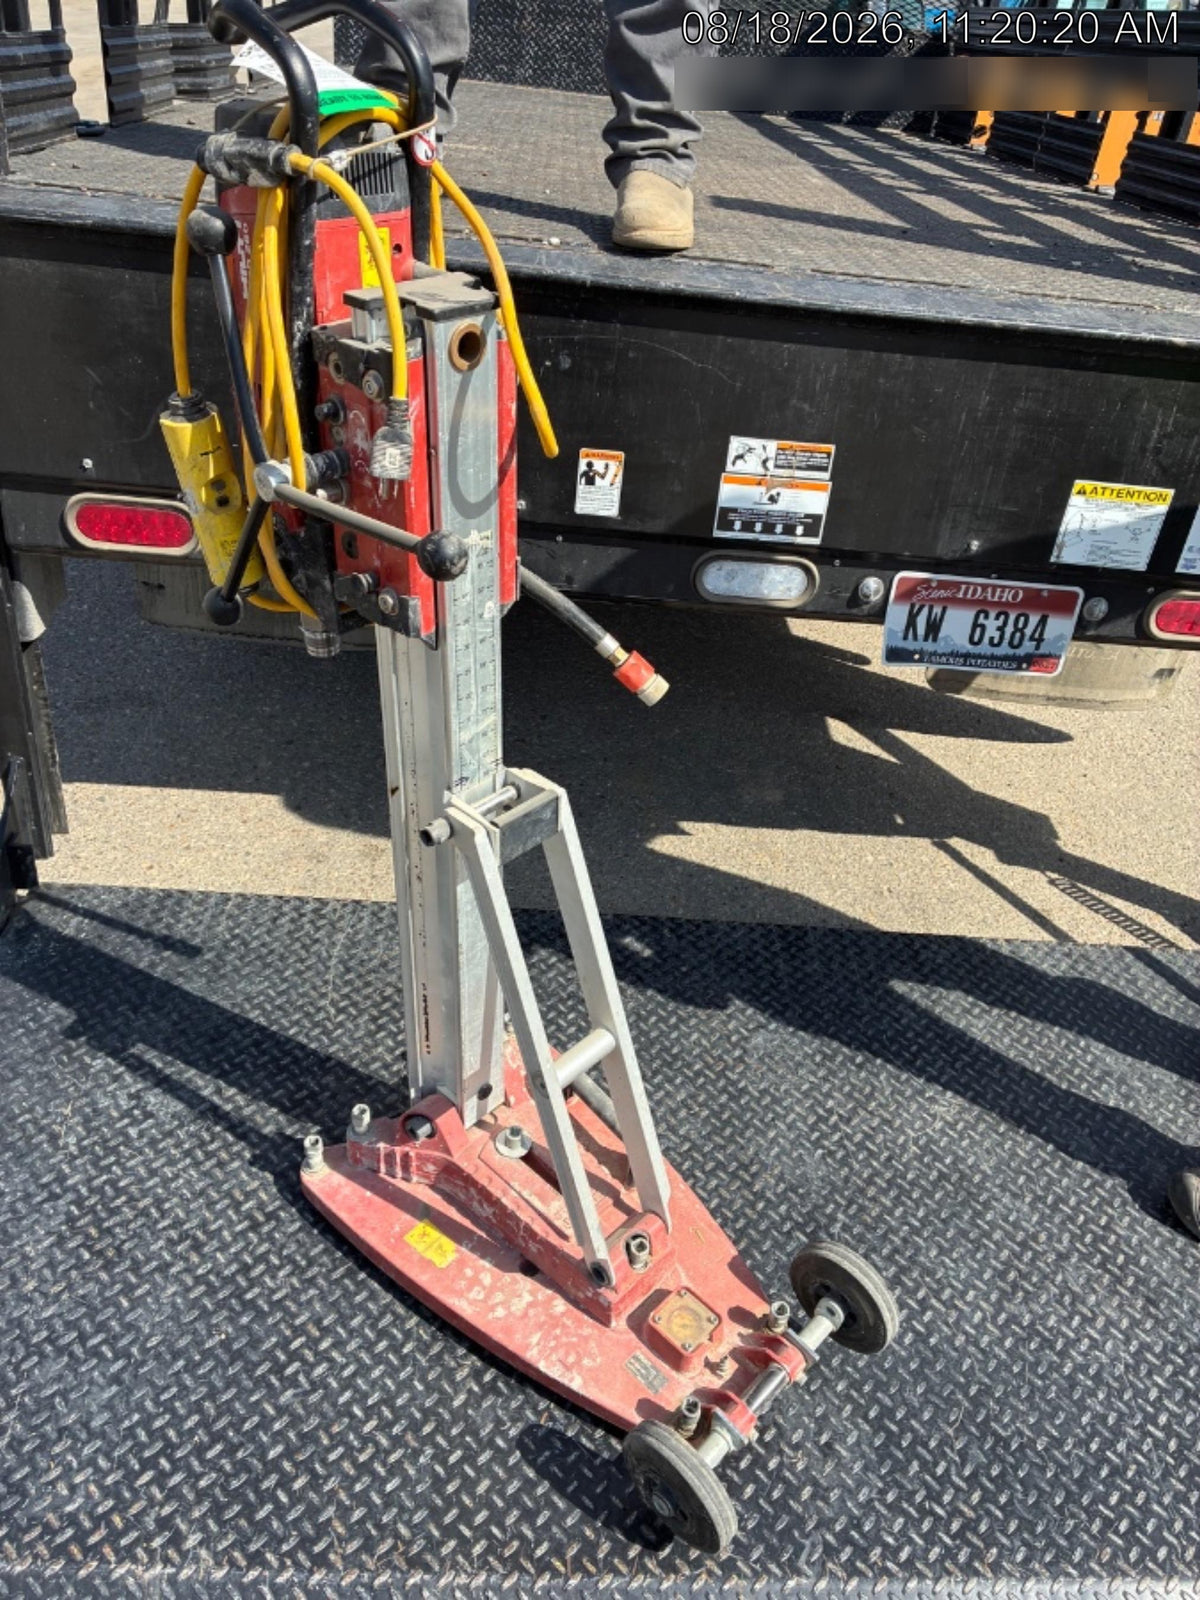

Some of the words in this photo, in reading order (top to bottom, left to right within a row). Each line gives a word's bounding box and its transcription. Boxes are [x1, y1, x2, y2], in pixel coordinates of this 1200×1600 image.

[1089, 486, 1169, 503] ATTENTION
[911, 584, 957, 602] Scenic
[956, 584, 1024, 603] IDAHO
[902, 602, 948, 643] KW
[968, 608, 1050, 651] 6384
